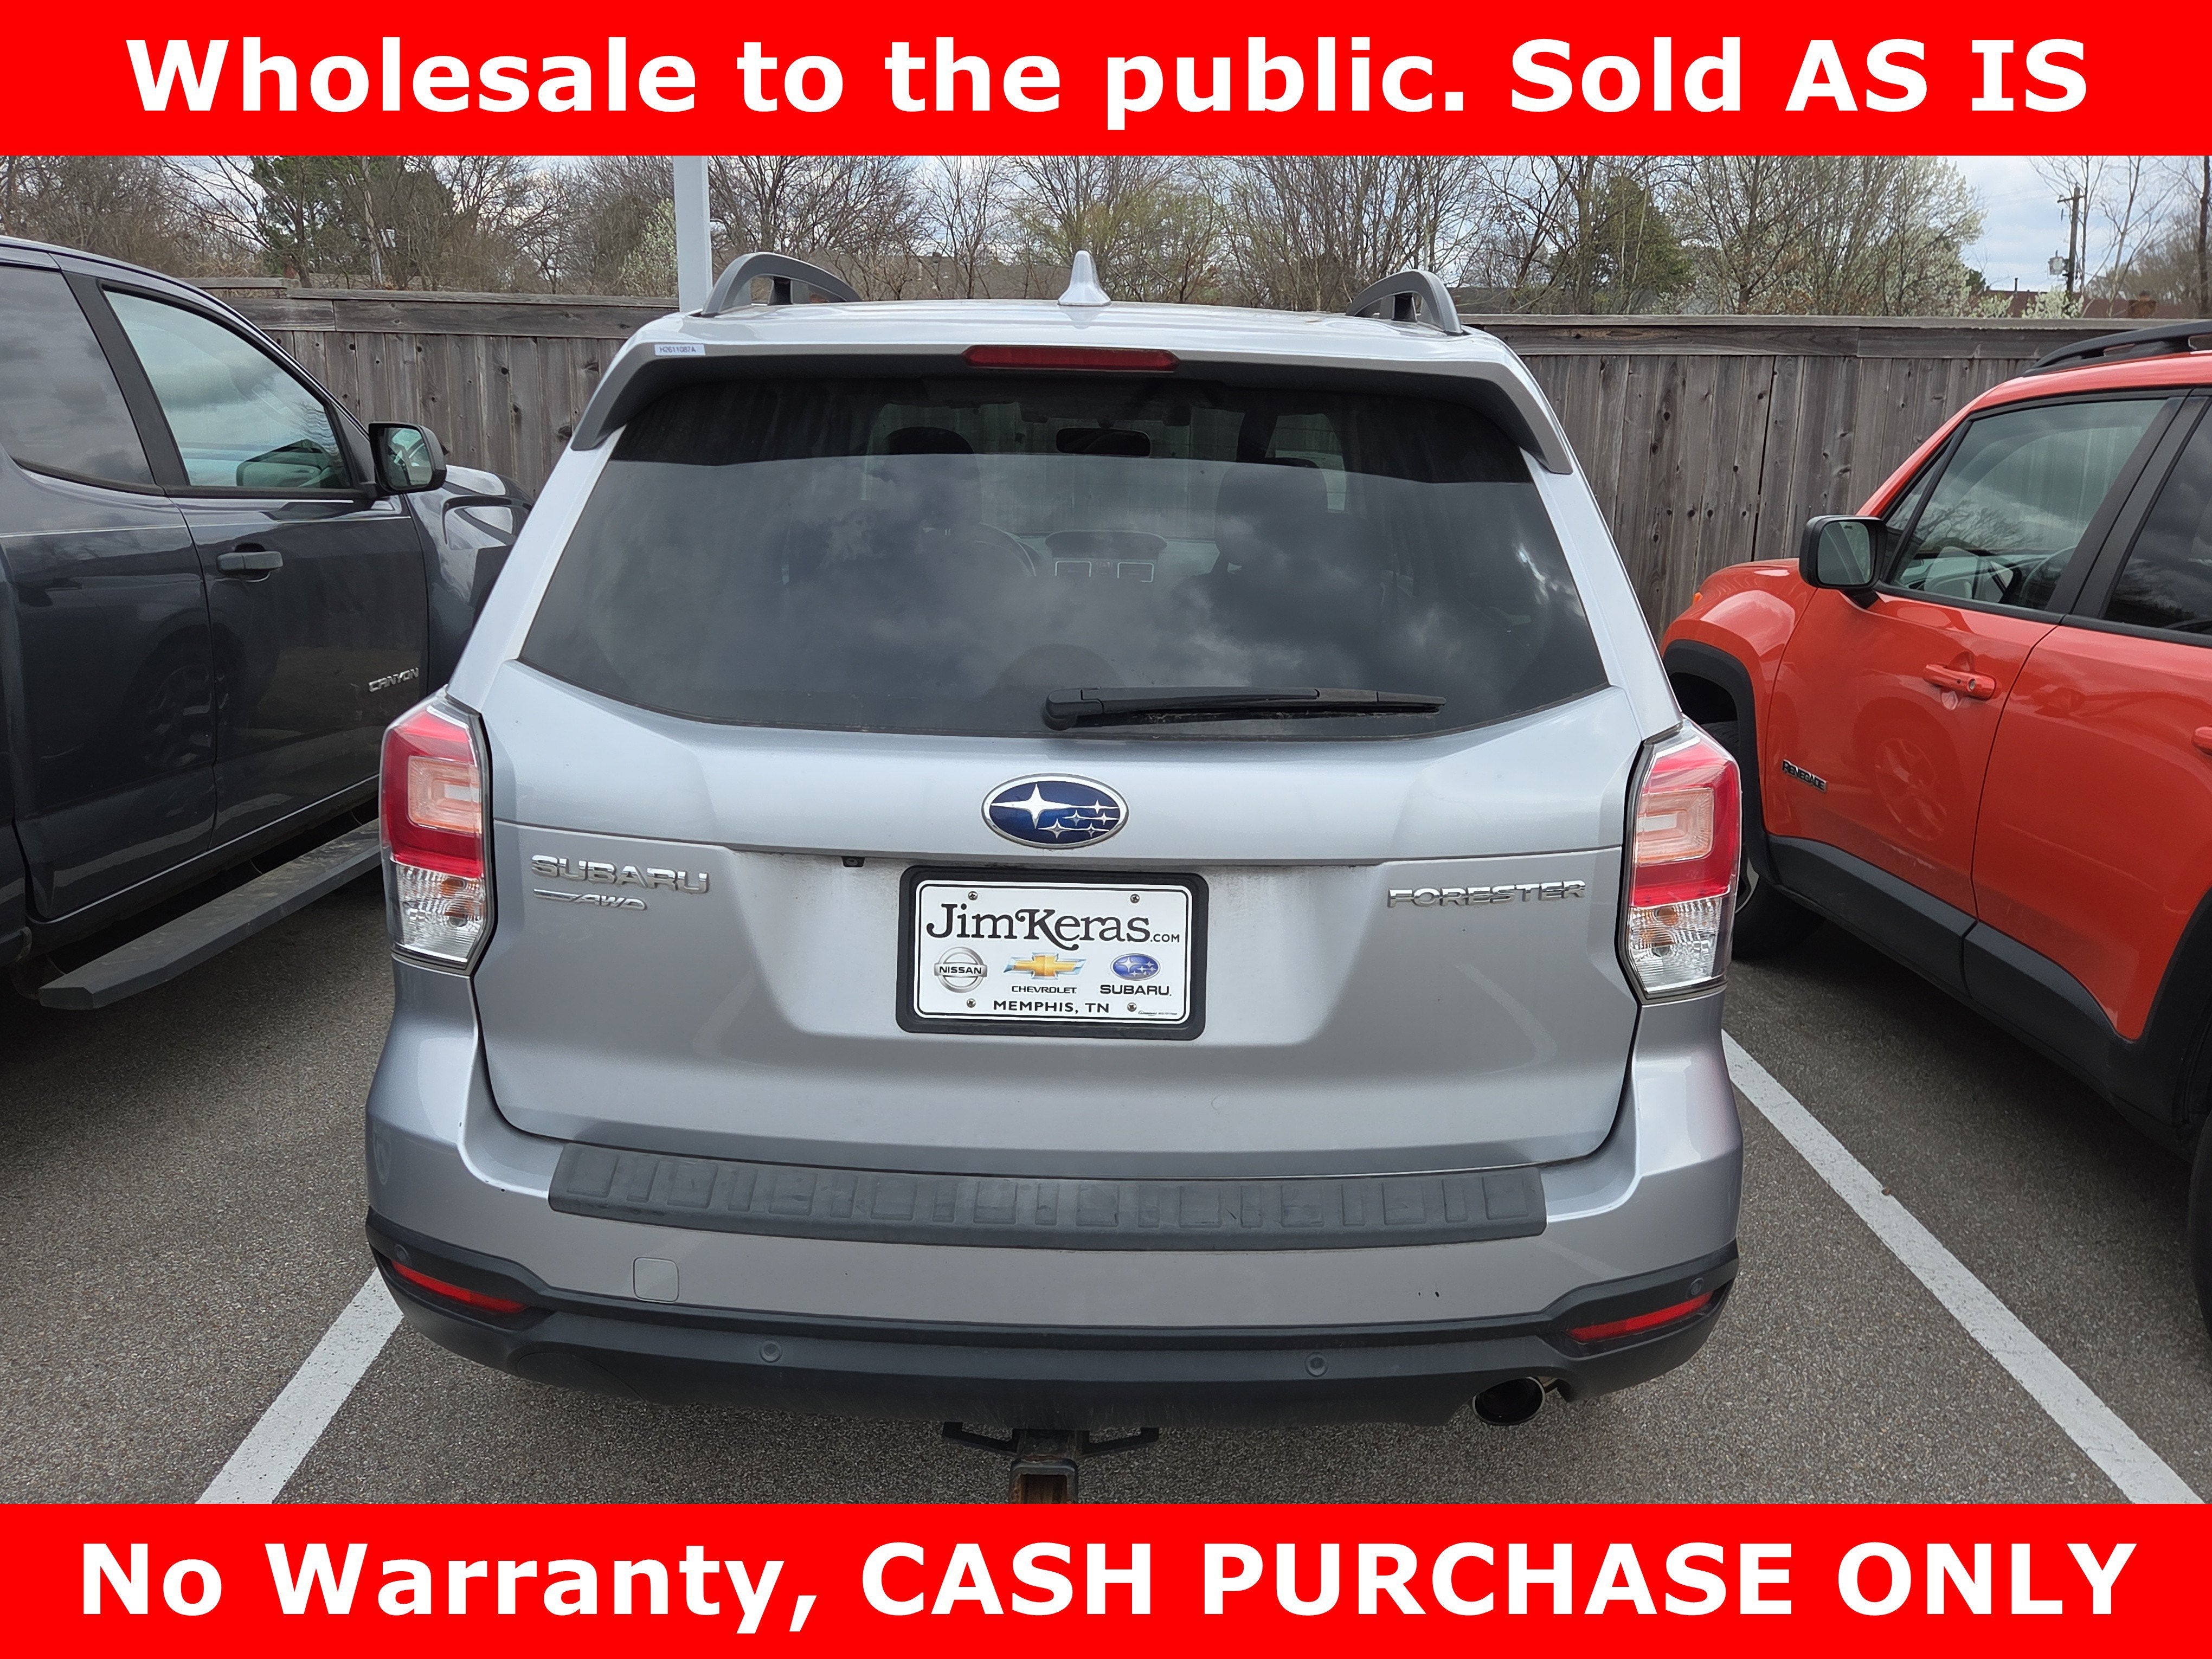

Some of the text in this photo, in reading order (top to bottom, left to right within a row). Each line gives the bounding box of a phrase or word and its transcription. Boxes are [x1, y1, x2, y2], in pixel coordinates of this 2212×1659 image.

[369, 667, 419, 692] CANYON
[1782, 759, 1827, 792] RENEGADE
[531, 854, 710, 895] SUBARU
[570, 893, 647, 911] AWD
[1387, 880, 1586, 908] FORESTER
[938, 965, 982, 975] NISSAN
[1011, 986, 1077, 994] CHEVROLET
[1099, 984, 1169, 996] SUBARU
[993, 1000, 1110, 1014] MEMPHIS, TN
